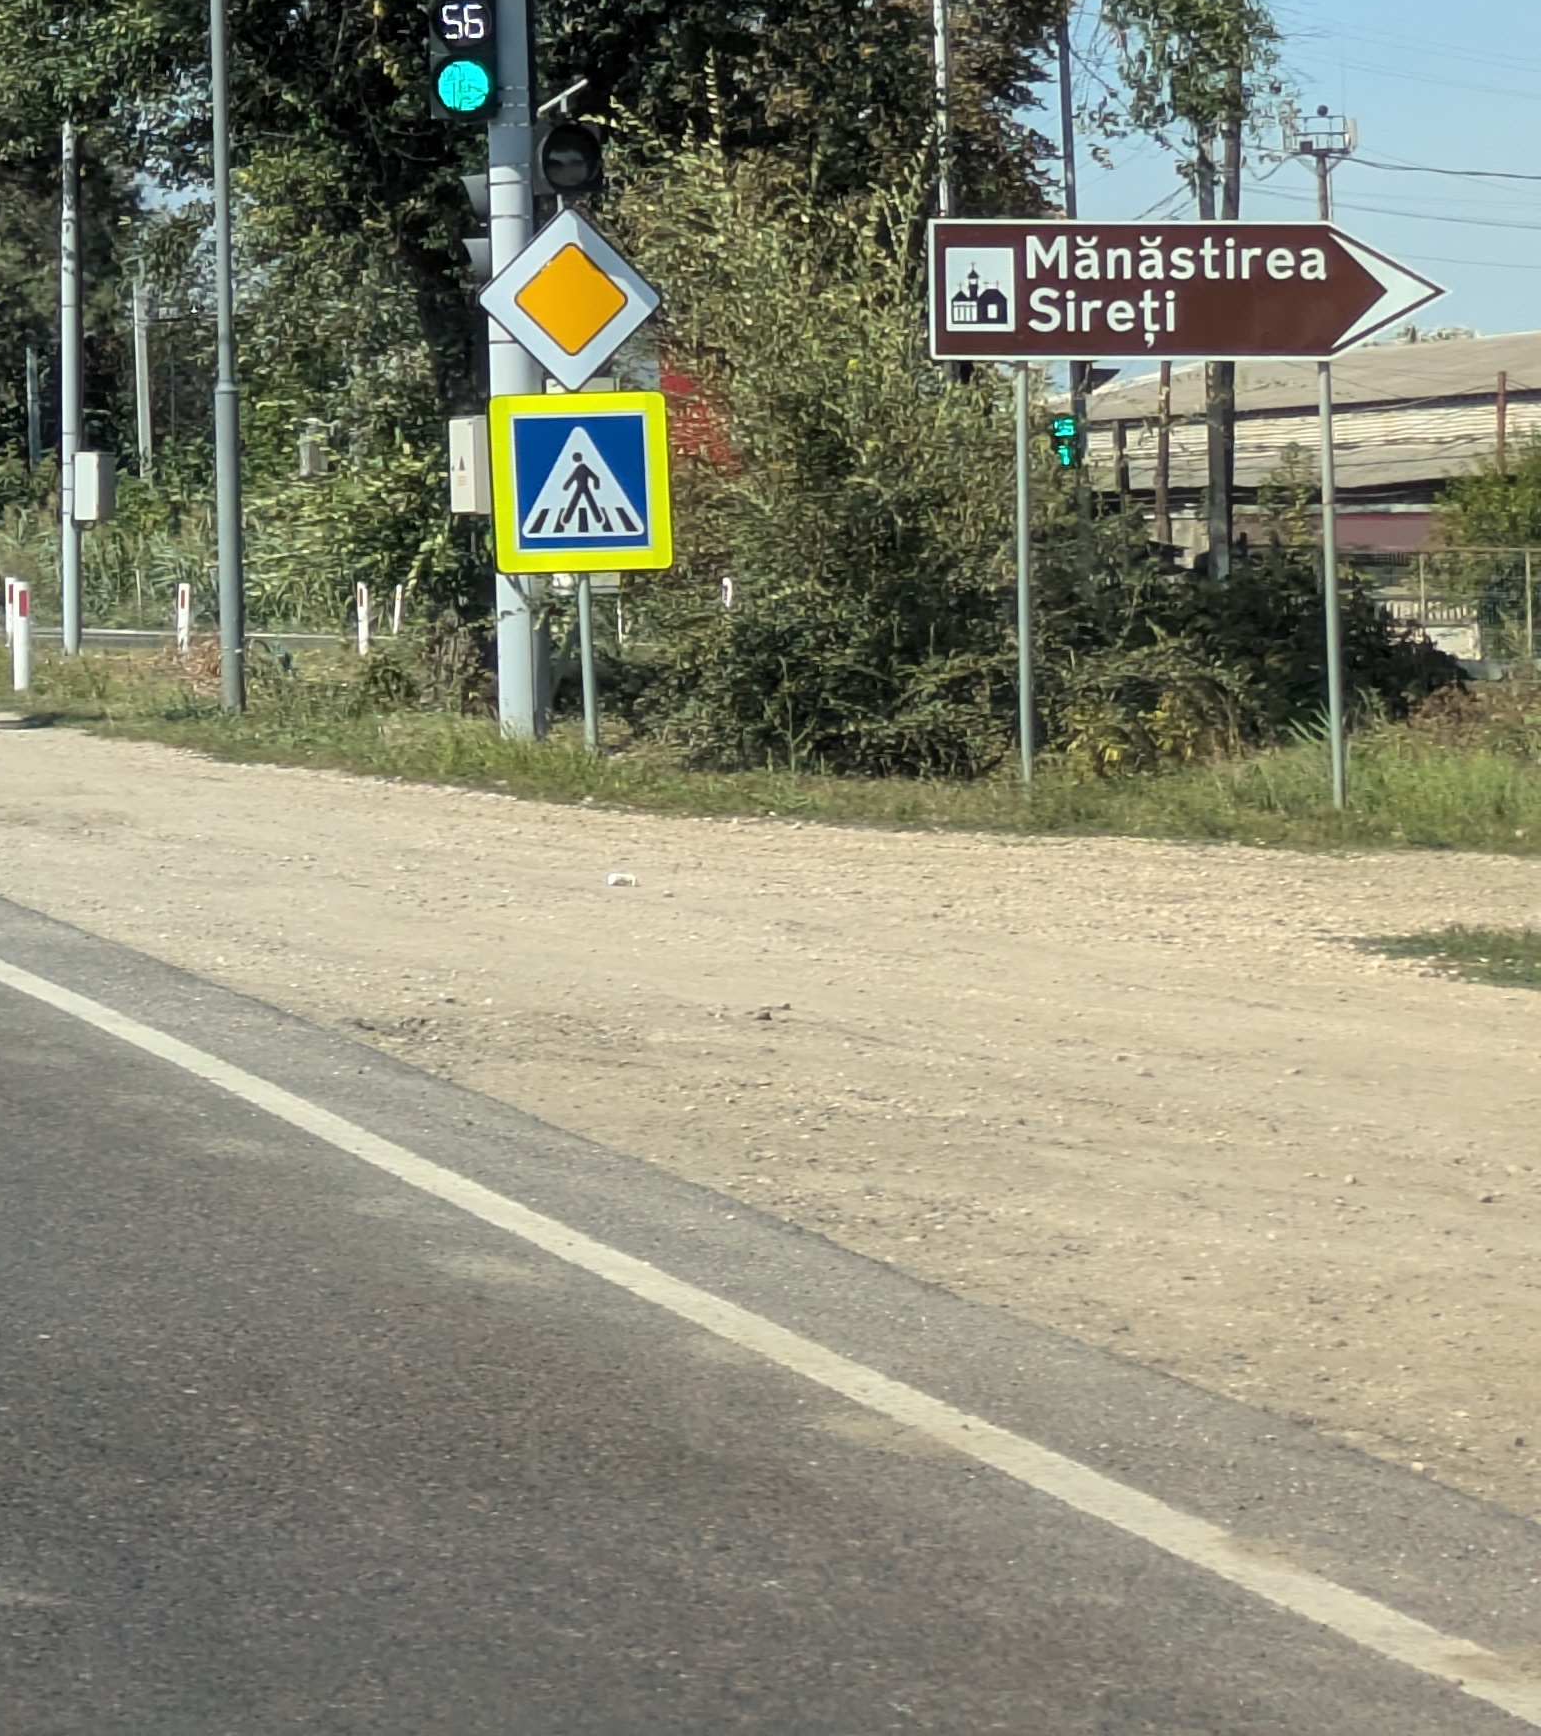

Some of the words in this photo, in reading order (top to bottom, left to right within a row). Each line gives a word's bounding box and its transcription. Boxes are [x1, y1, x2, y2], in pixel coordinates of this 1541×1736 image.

[440, 3, 486, 41] 56
[1024, 234, 1328, 281] Mănăstirea
[1026, 286, 1177, 349] Sireți
